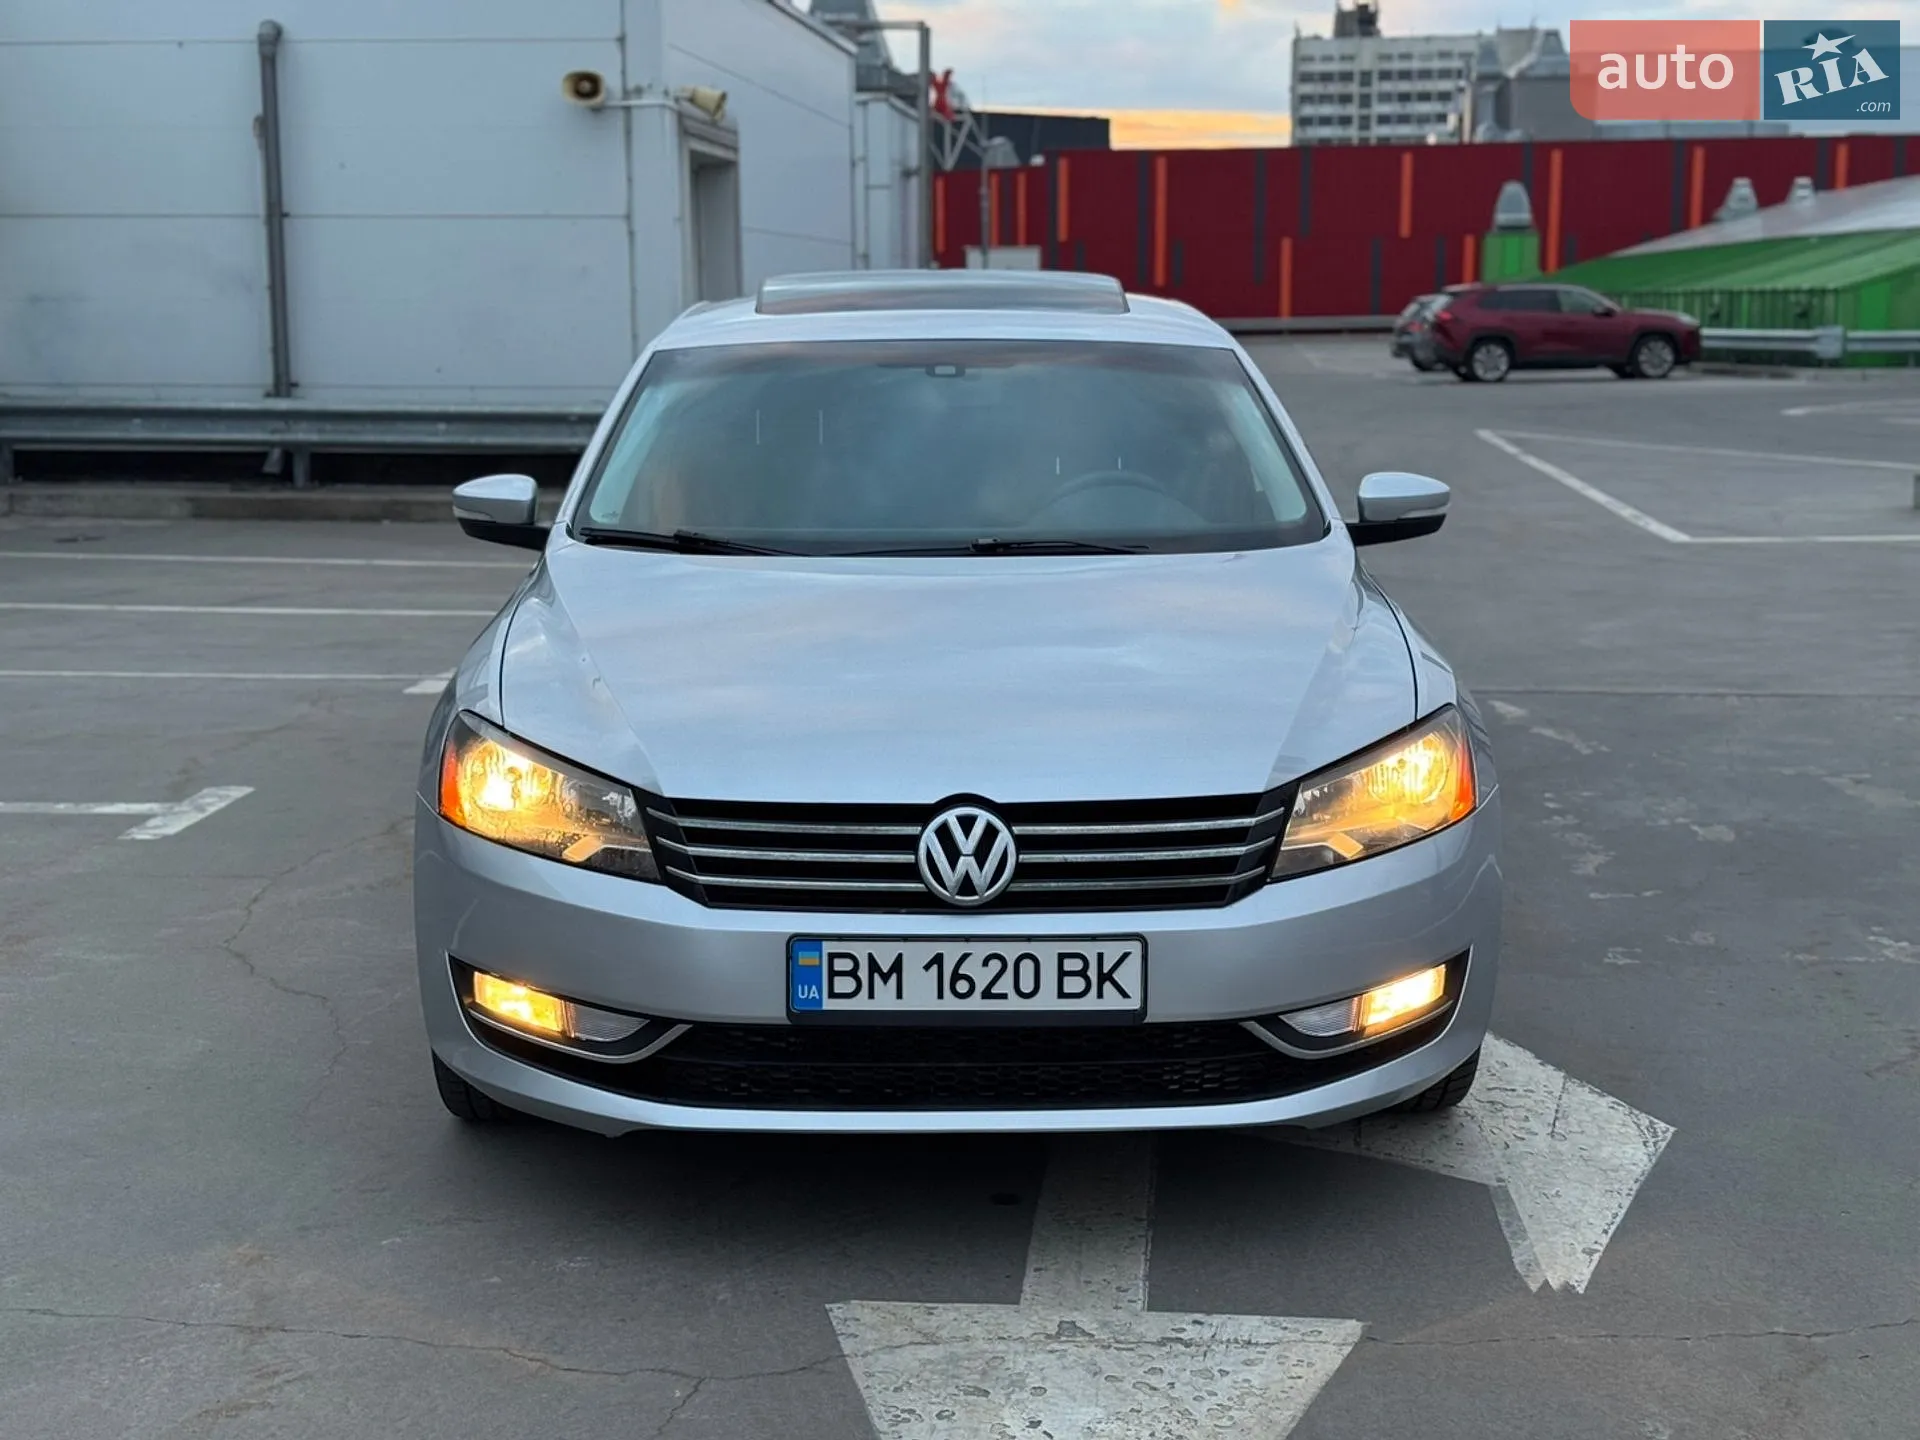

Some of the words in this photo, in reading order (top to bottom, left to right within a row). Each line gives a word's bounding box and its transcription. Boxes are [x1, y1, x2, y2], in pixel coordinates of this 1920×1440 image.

[797, 984, 819, 1000] UA
[827, 952, 903, 1000] BM
[922, 952, 1041, 1000] 1620
[1056, 952, 1132, 1000] BK
